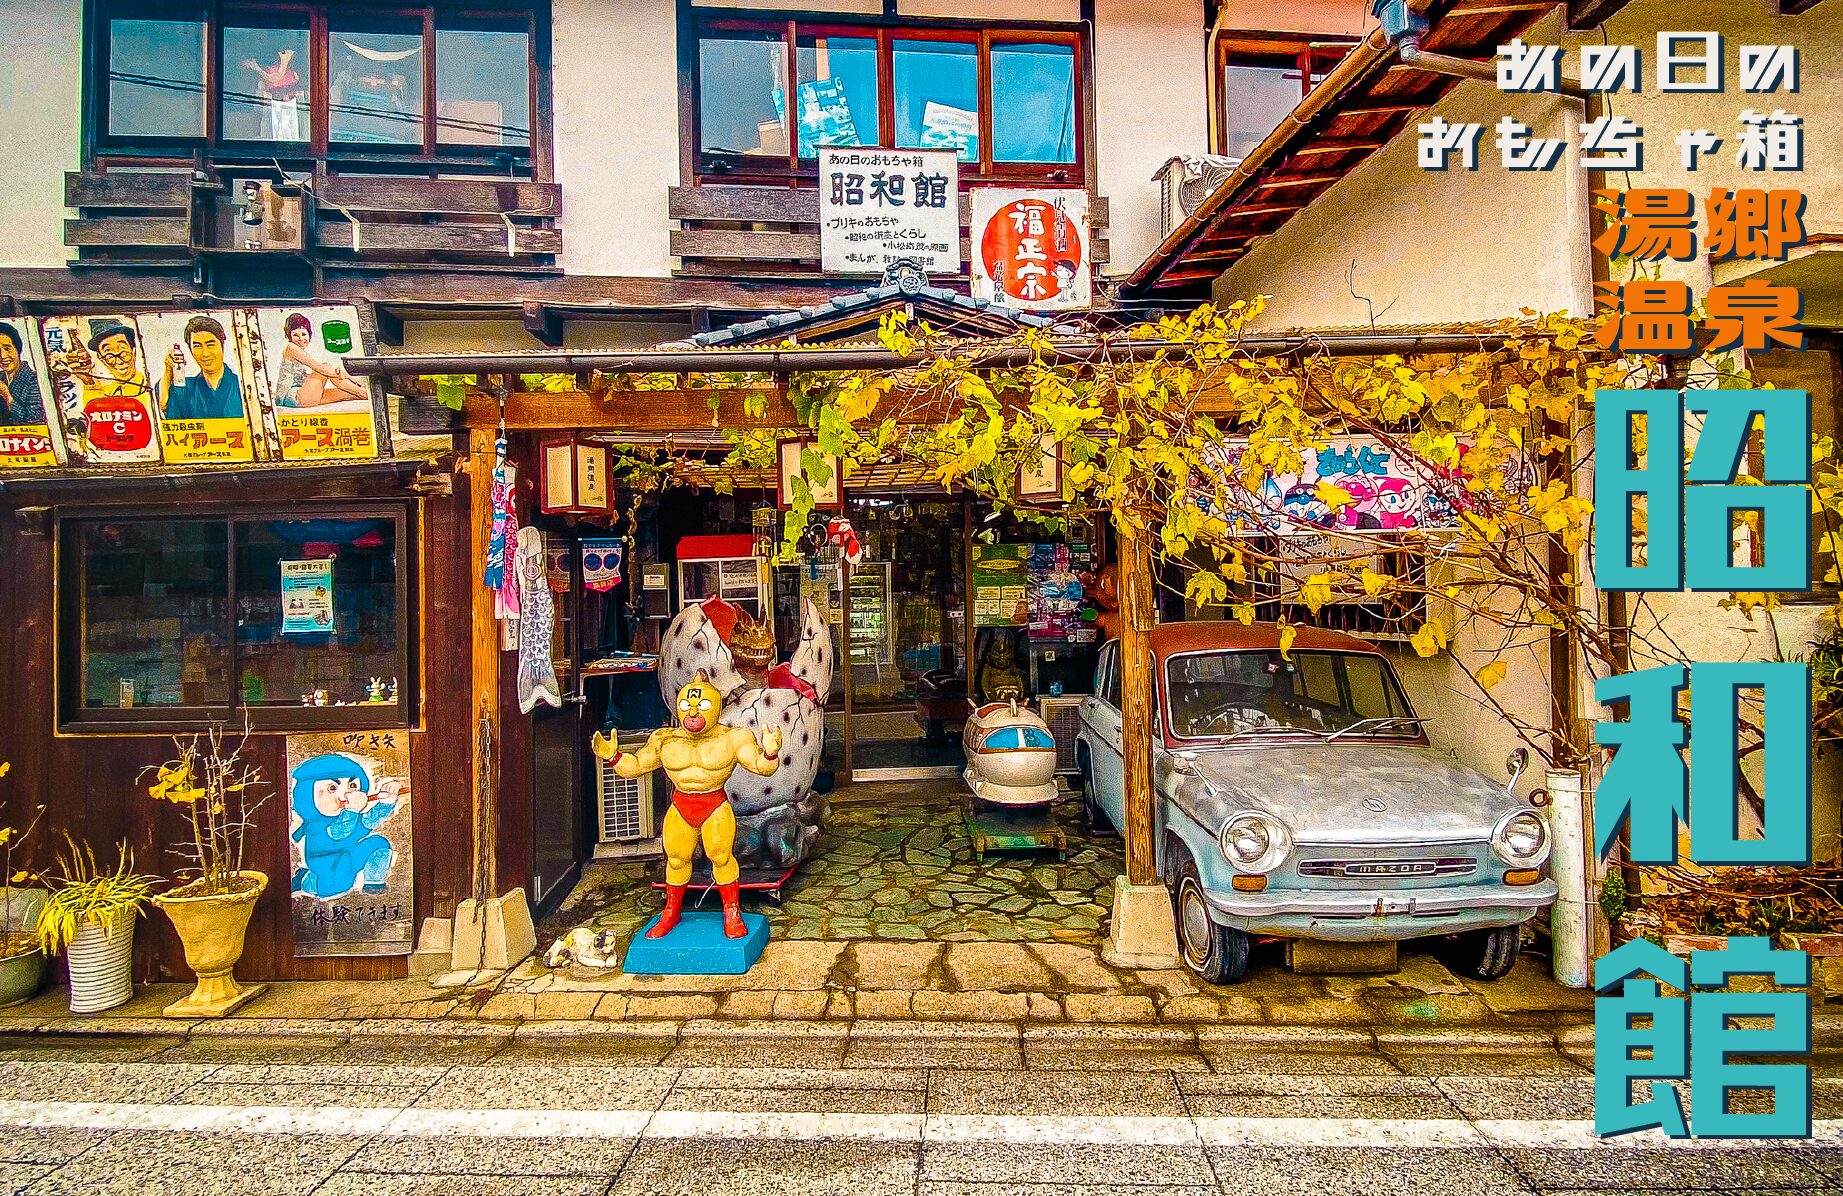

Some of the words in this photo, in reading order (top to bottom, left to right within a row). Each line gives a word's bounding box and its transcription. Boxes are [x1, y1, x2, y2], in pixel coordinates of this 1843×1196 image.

[829, 153, 924, 168] あの日のおもちゃ箱
[830, 170, 949, 208] 昭和館
[1008, 203, 1048, 299] 福正宗
[89, 410, 143, 422] オロナミン
[113, 422, 126, 434] C
[166, 431, 245, 449] ハイアース
[281, 427, 371, 448] アース渦巻
[687, 688, 702, 699] 肉
[342, 734, 397, 750] 吹き矢
[1360, 864, 1422, 873] MAZDA
[311, 904, 402, 927] 体験できます
